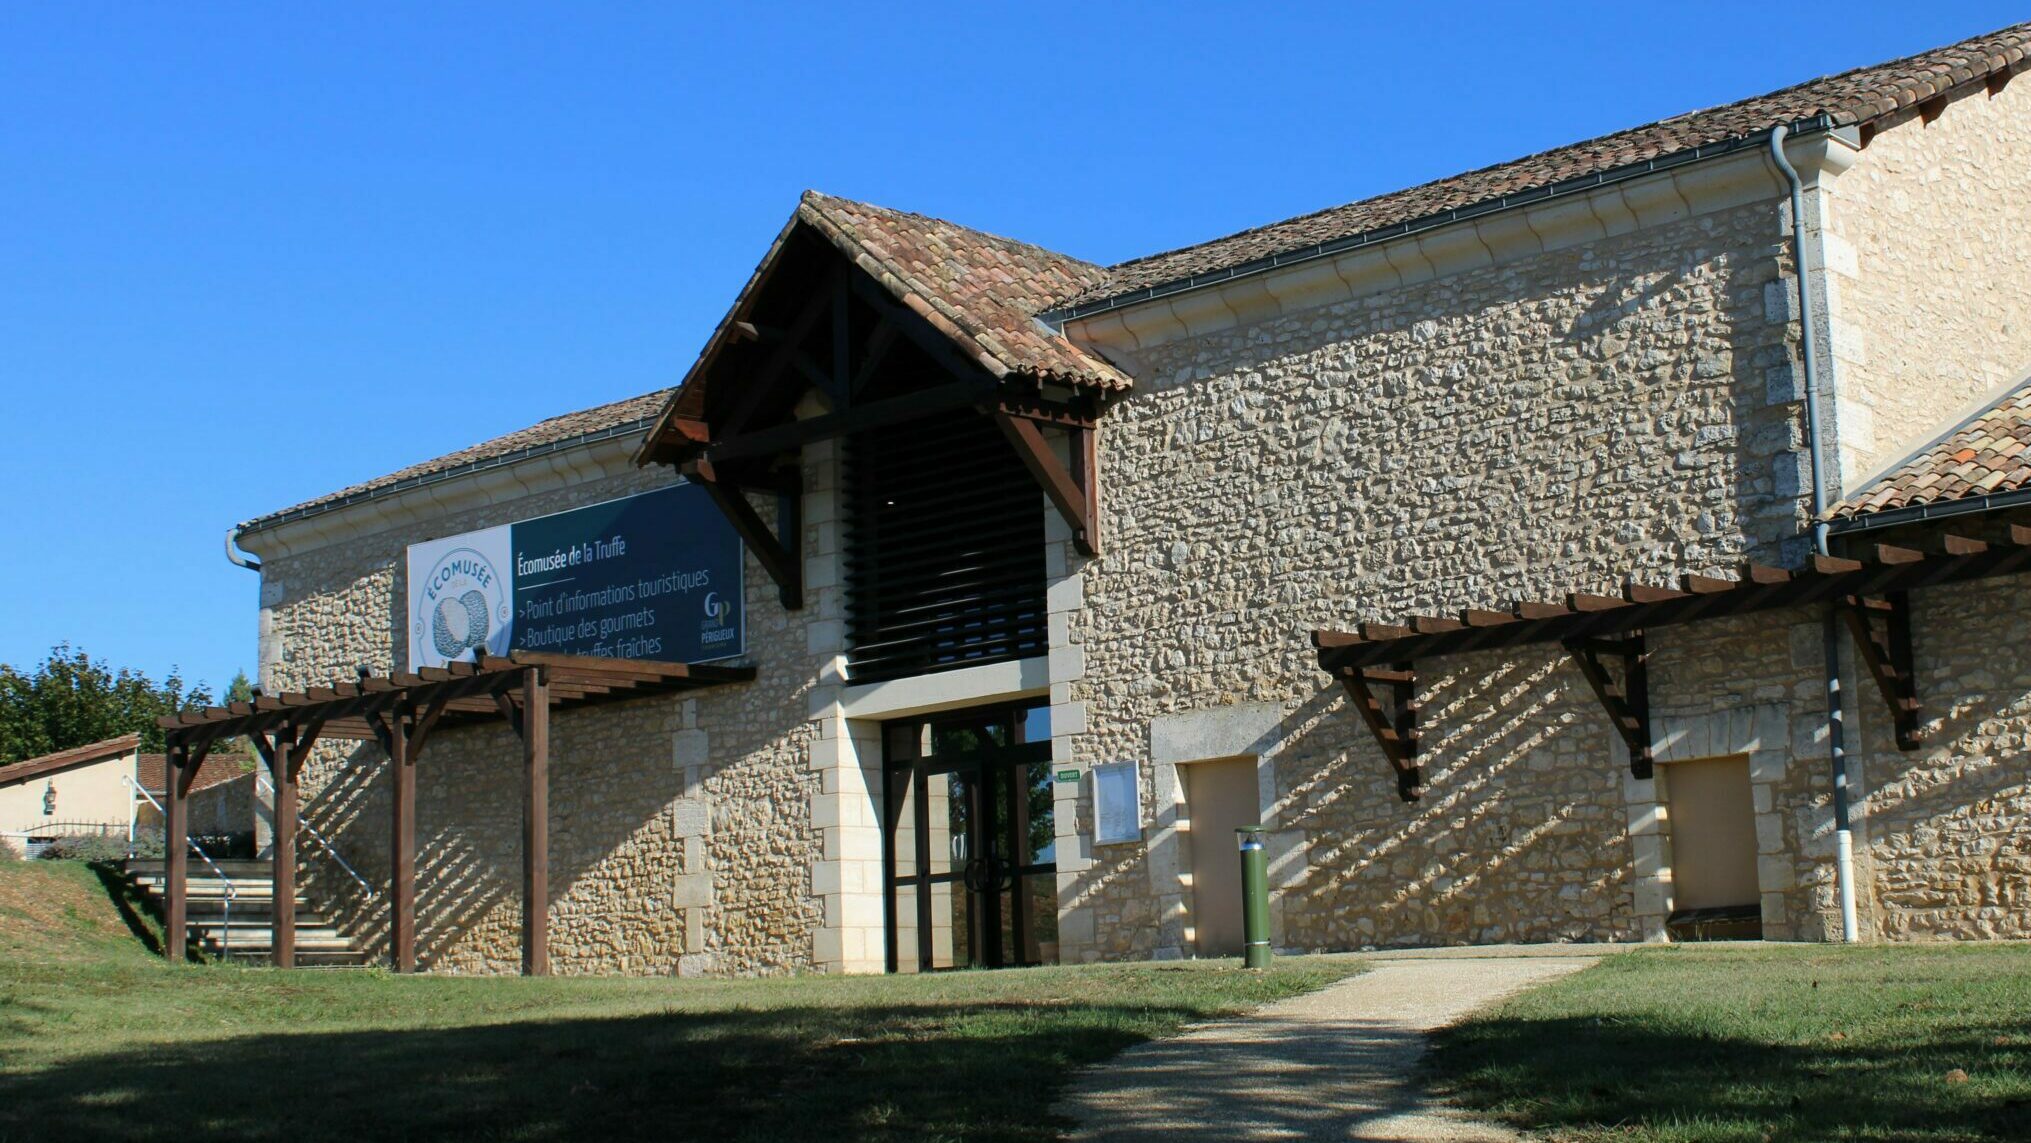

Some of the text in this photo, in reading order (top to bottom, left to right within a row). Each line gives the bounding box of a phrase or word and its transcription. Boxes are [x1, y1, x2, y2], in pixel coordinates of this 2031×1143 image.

[518, 535, 625, 576] Écomusée de la Truffe
[427, 560, 492, 600] ÉCOMUSÉE
[527, 569, 709, 620] Point d'informations touristiques
[527, 609, 655, 648] Boutique des gourmets
[616, 636, 662, 659] fraîches
